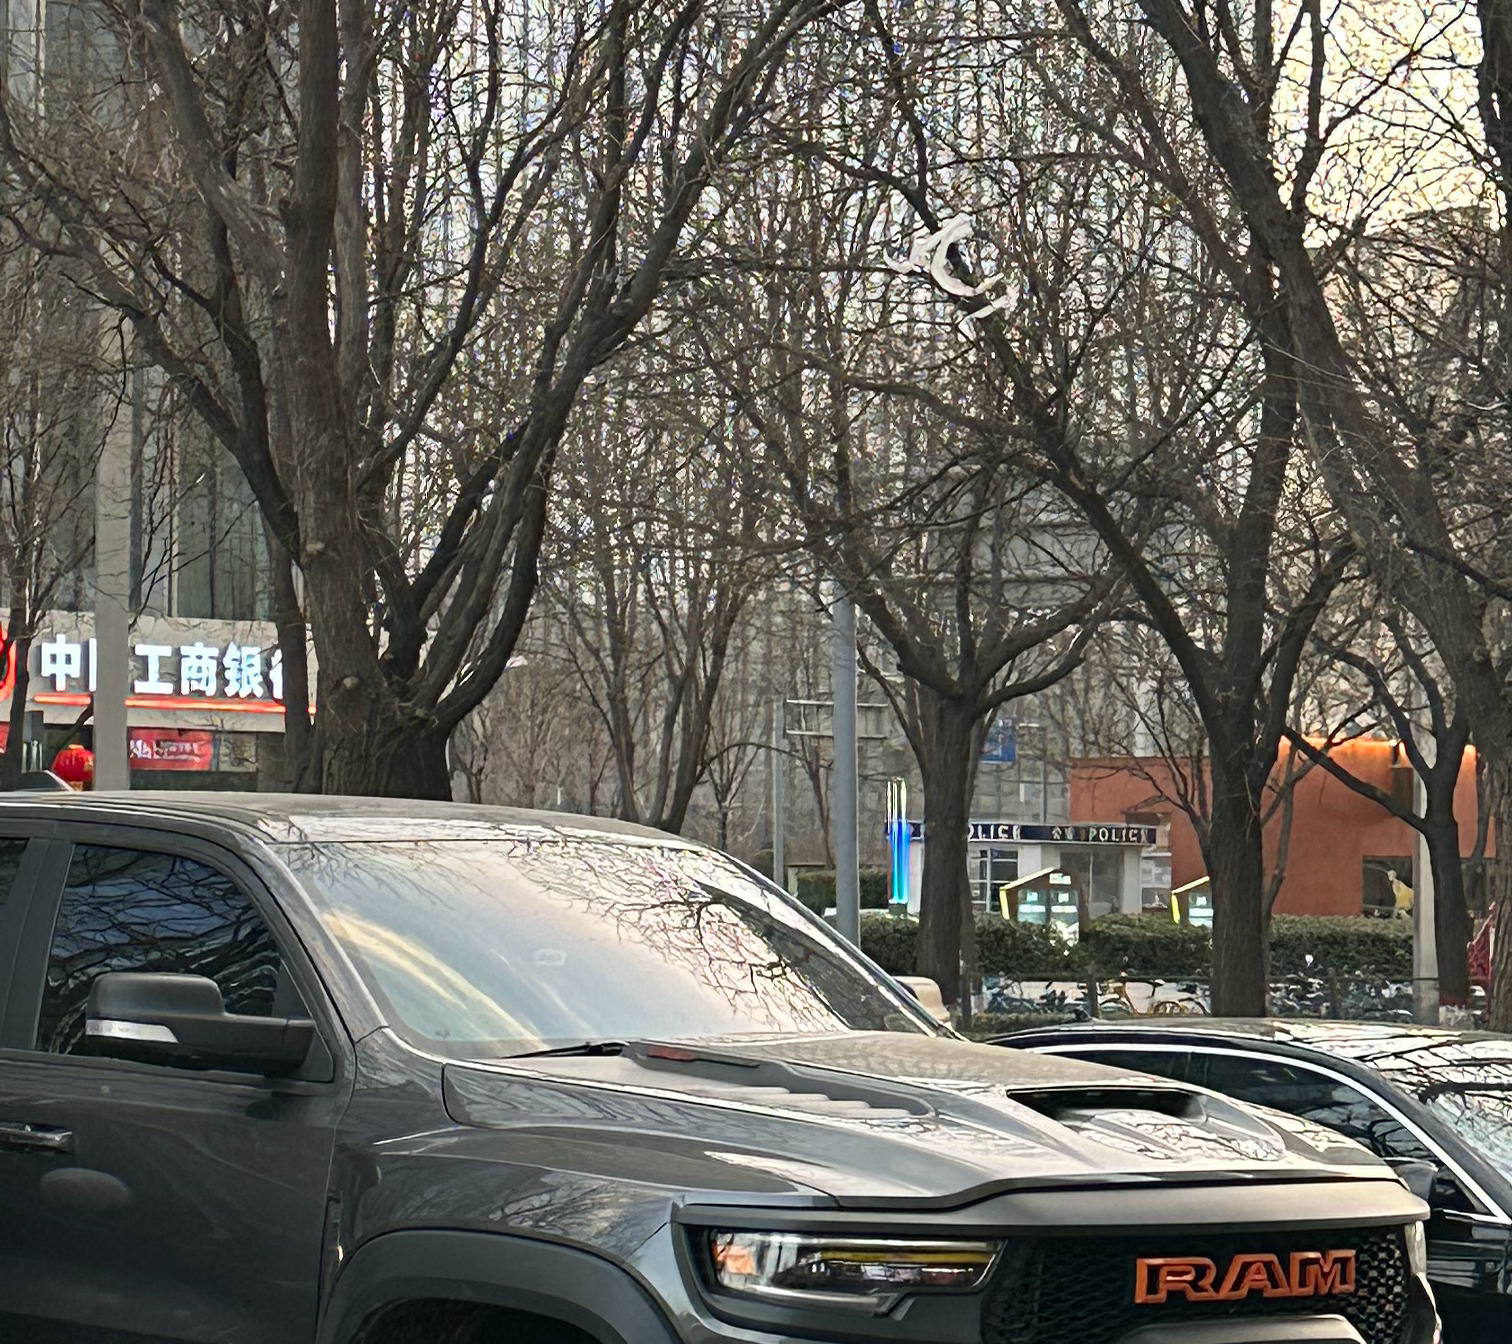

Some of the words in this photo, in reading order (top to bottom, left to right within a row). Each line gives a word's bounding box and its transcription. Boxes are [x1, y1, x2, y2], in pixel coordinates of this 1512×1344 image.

[41, 633, 284, 699] 中工商银
[1134, 1249, 1357, 1304] RAM
